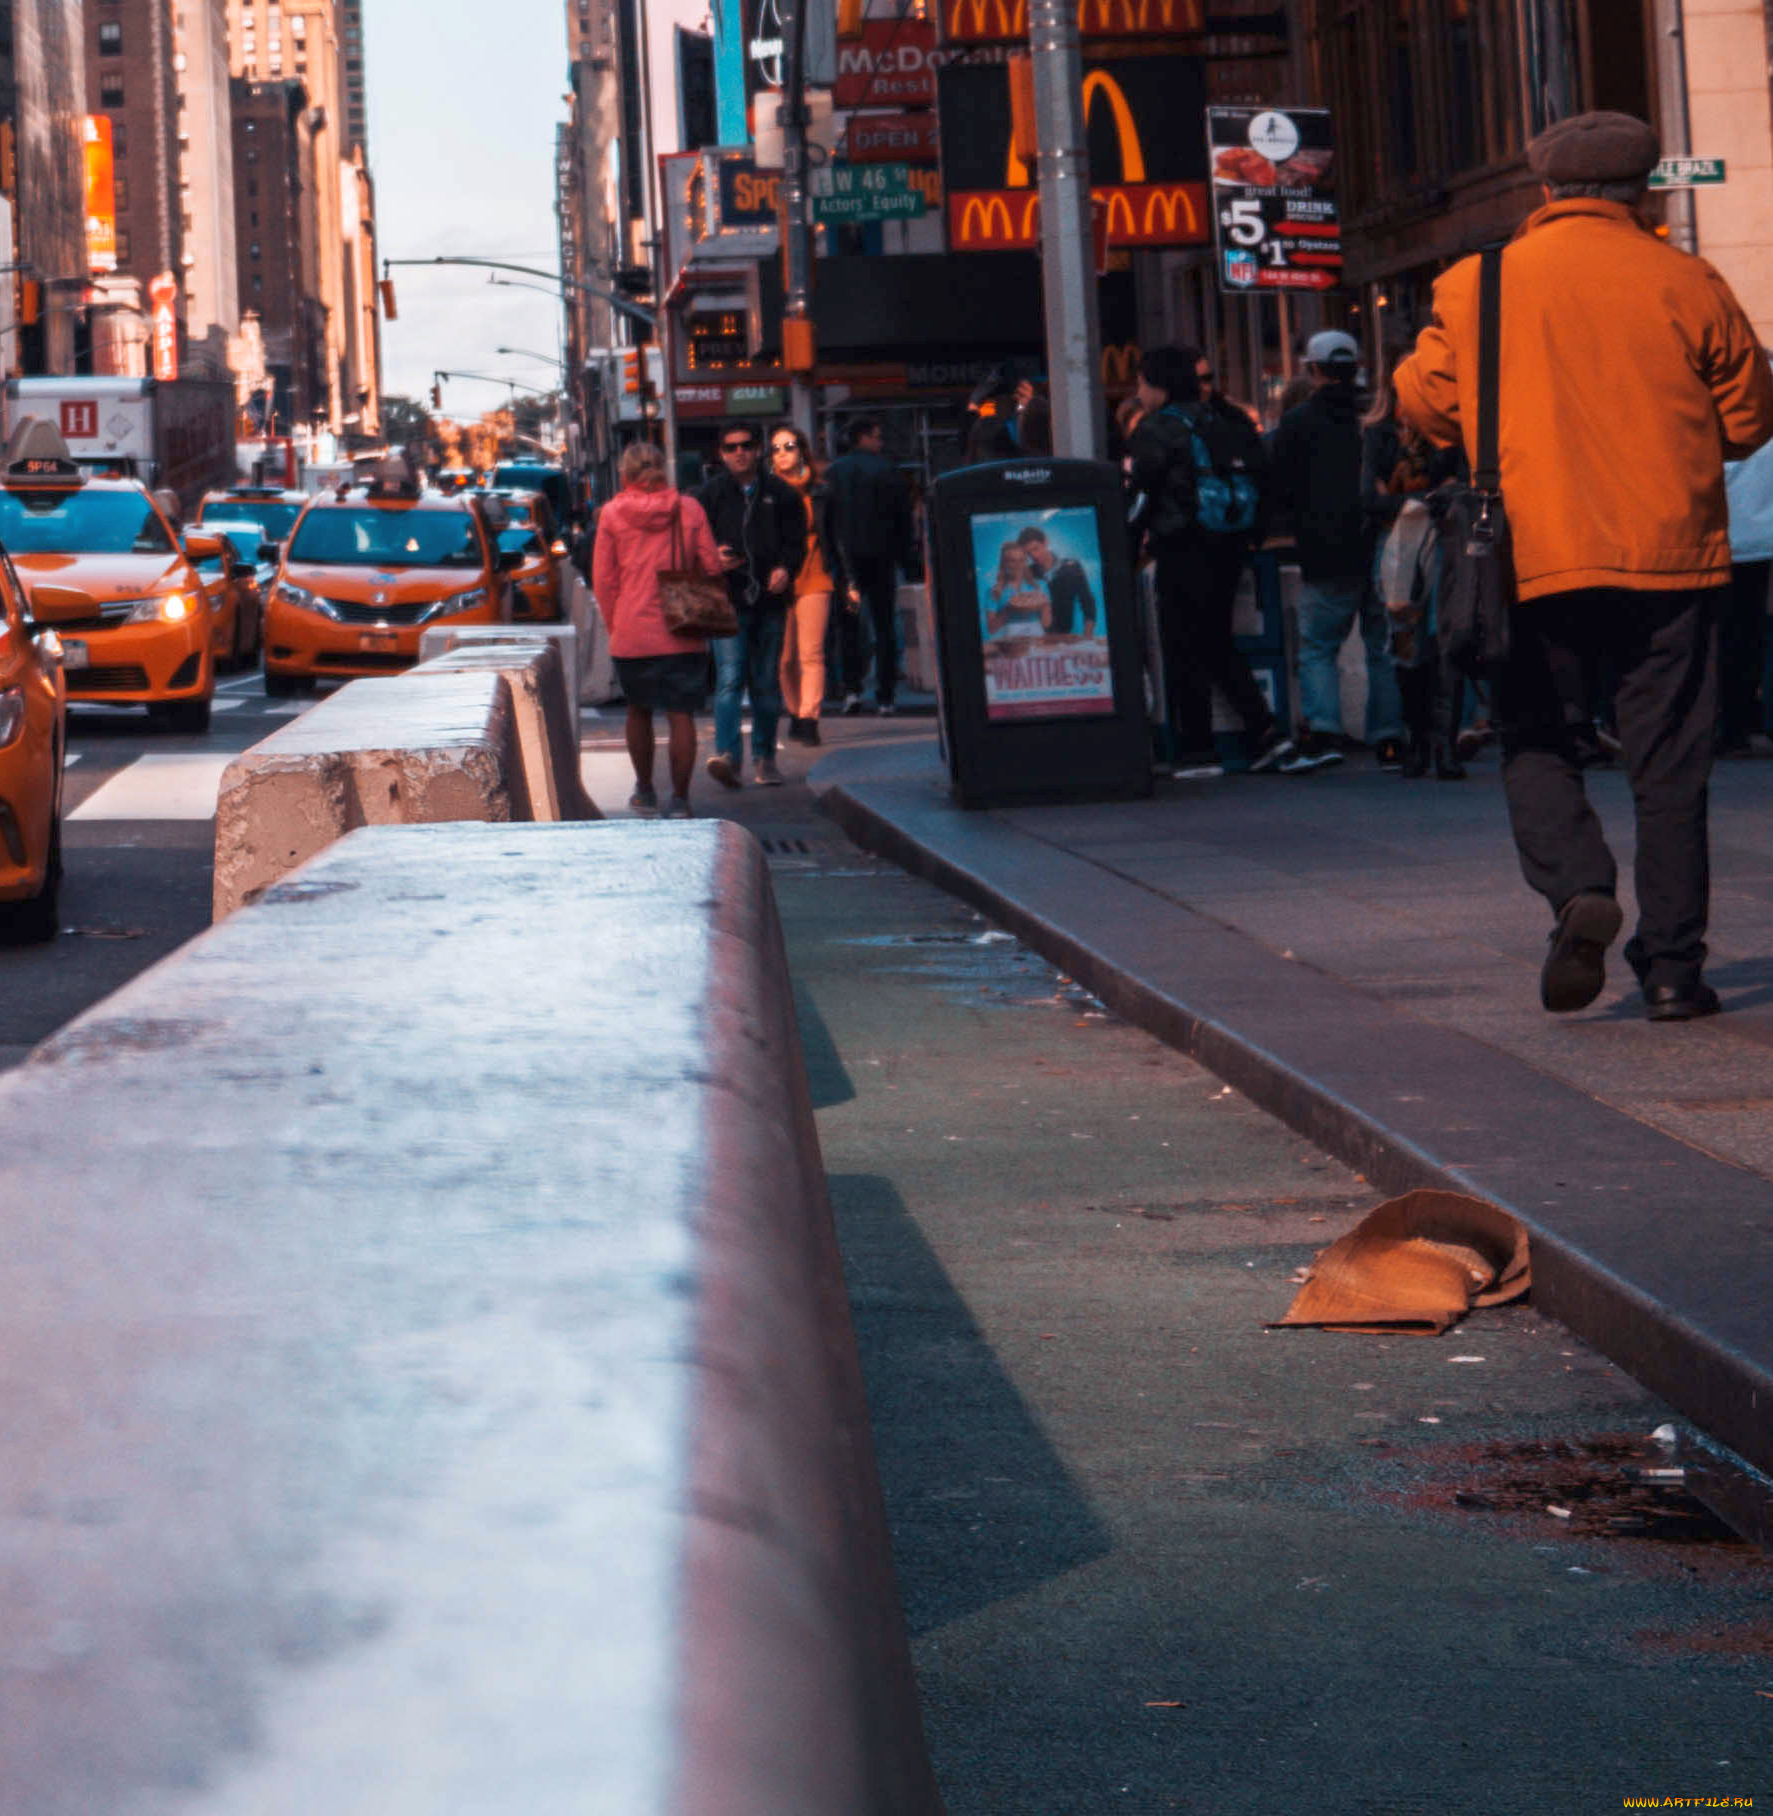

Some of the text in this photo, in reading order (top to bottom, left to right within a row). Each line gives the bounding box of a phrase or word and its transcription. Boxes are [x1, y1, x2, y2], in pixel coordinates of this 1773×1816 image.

[855, 129, 919, 147] OPEN
[862, 168, 887, 190] 46
[1245, 184, 1314, 198] great food!
[872, 193, 917, 212] Equity
[558, 159, 576, 298] WELLINGTON
[1220, 199, 1335, 247] $5 DRINK
[991, 651, 1105, 691] WAITRESS
